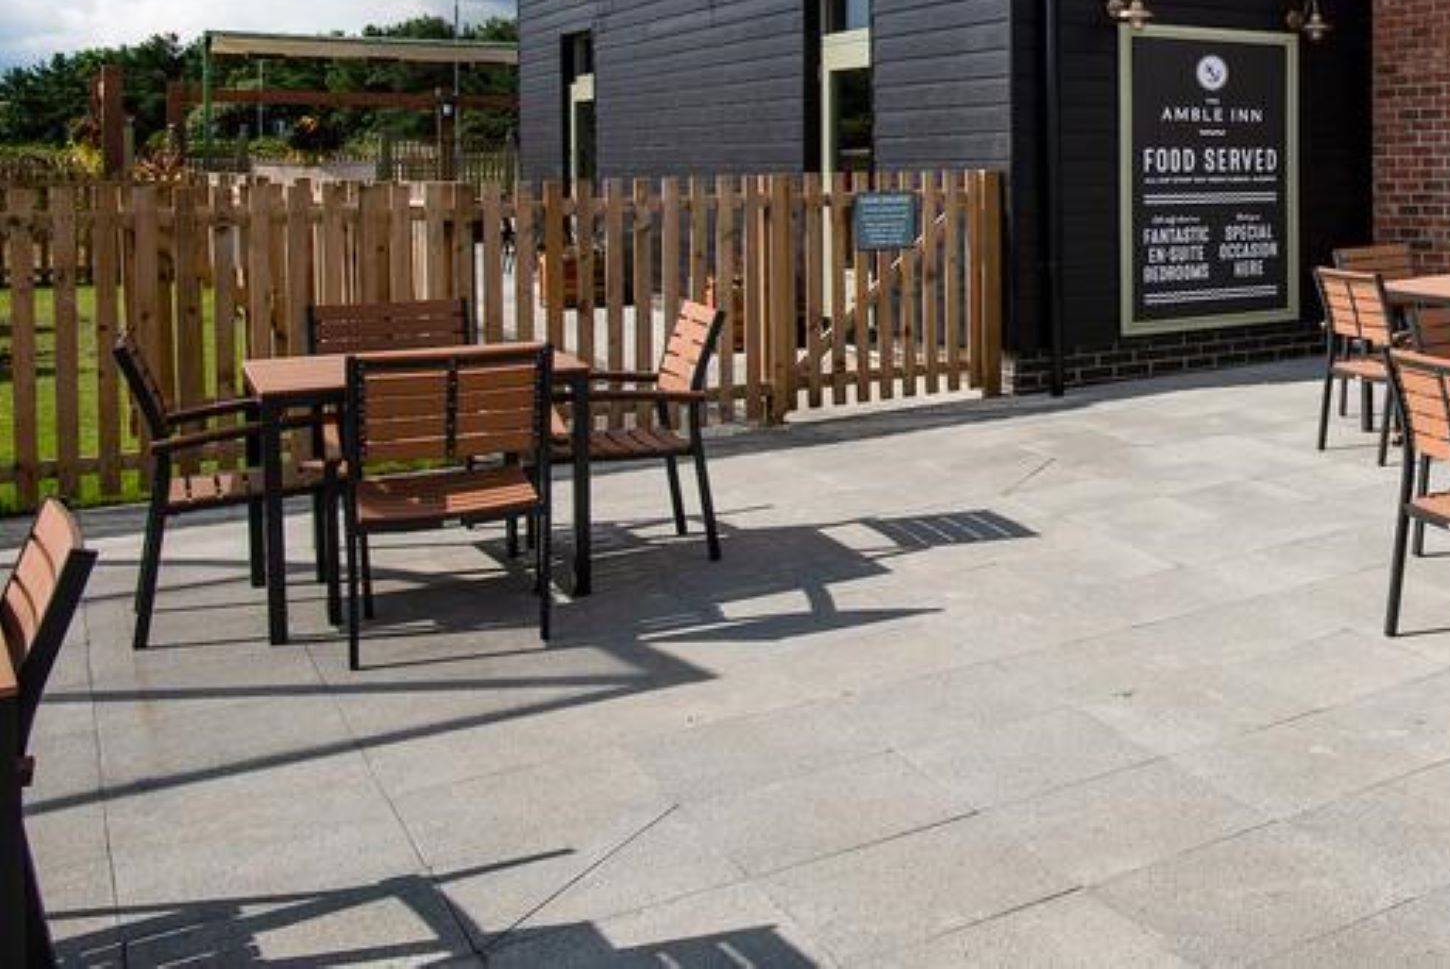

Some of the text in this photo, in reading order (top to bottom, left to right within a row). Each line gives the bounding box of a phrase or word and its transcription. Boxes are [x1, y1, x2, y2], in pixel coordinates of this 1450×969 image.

[1161, 106, 1263, 123] AMBLE INN
[1143, 147, 1278, 173] FOOD SERVED
